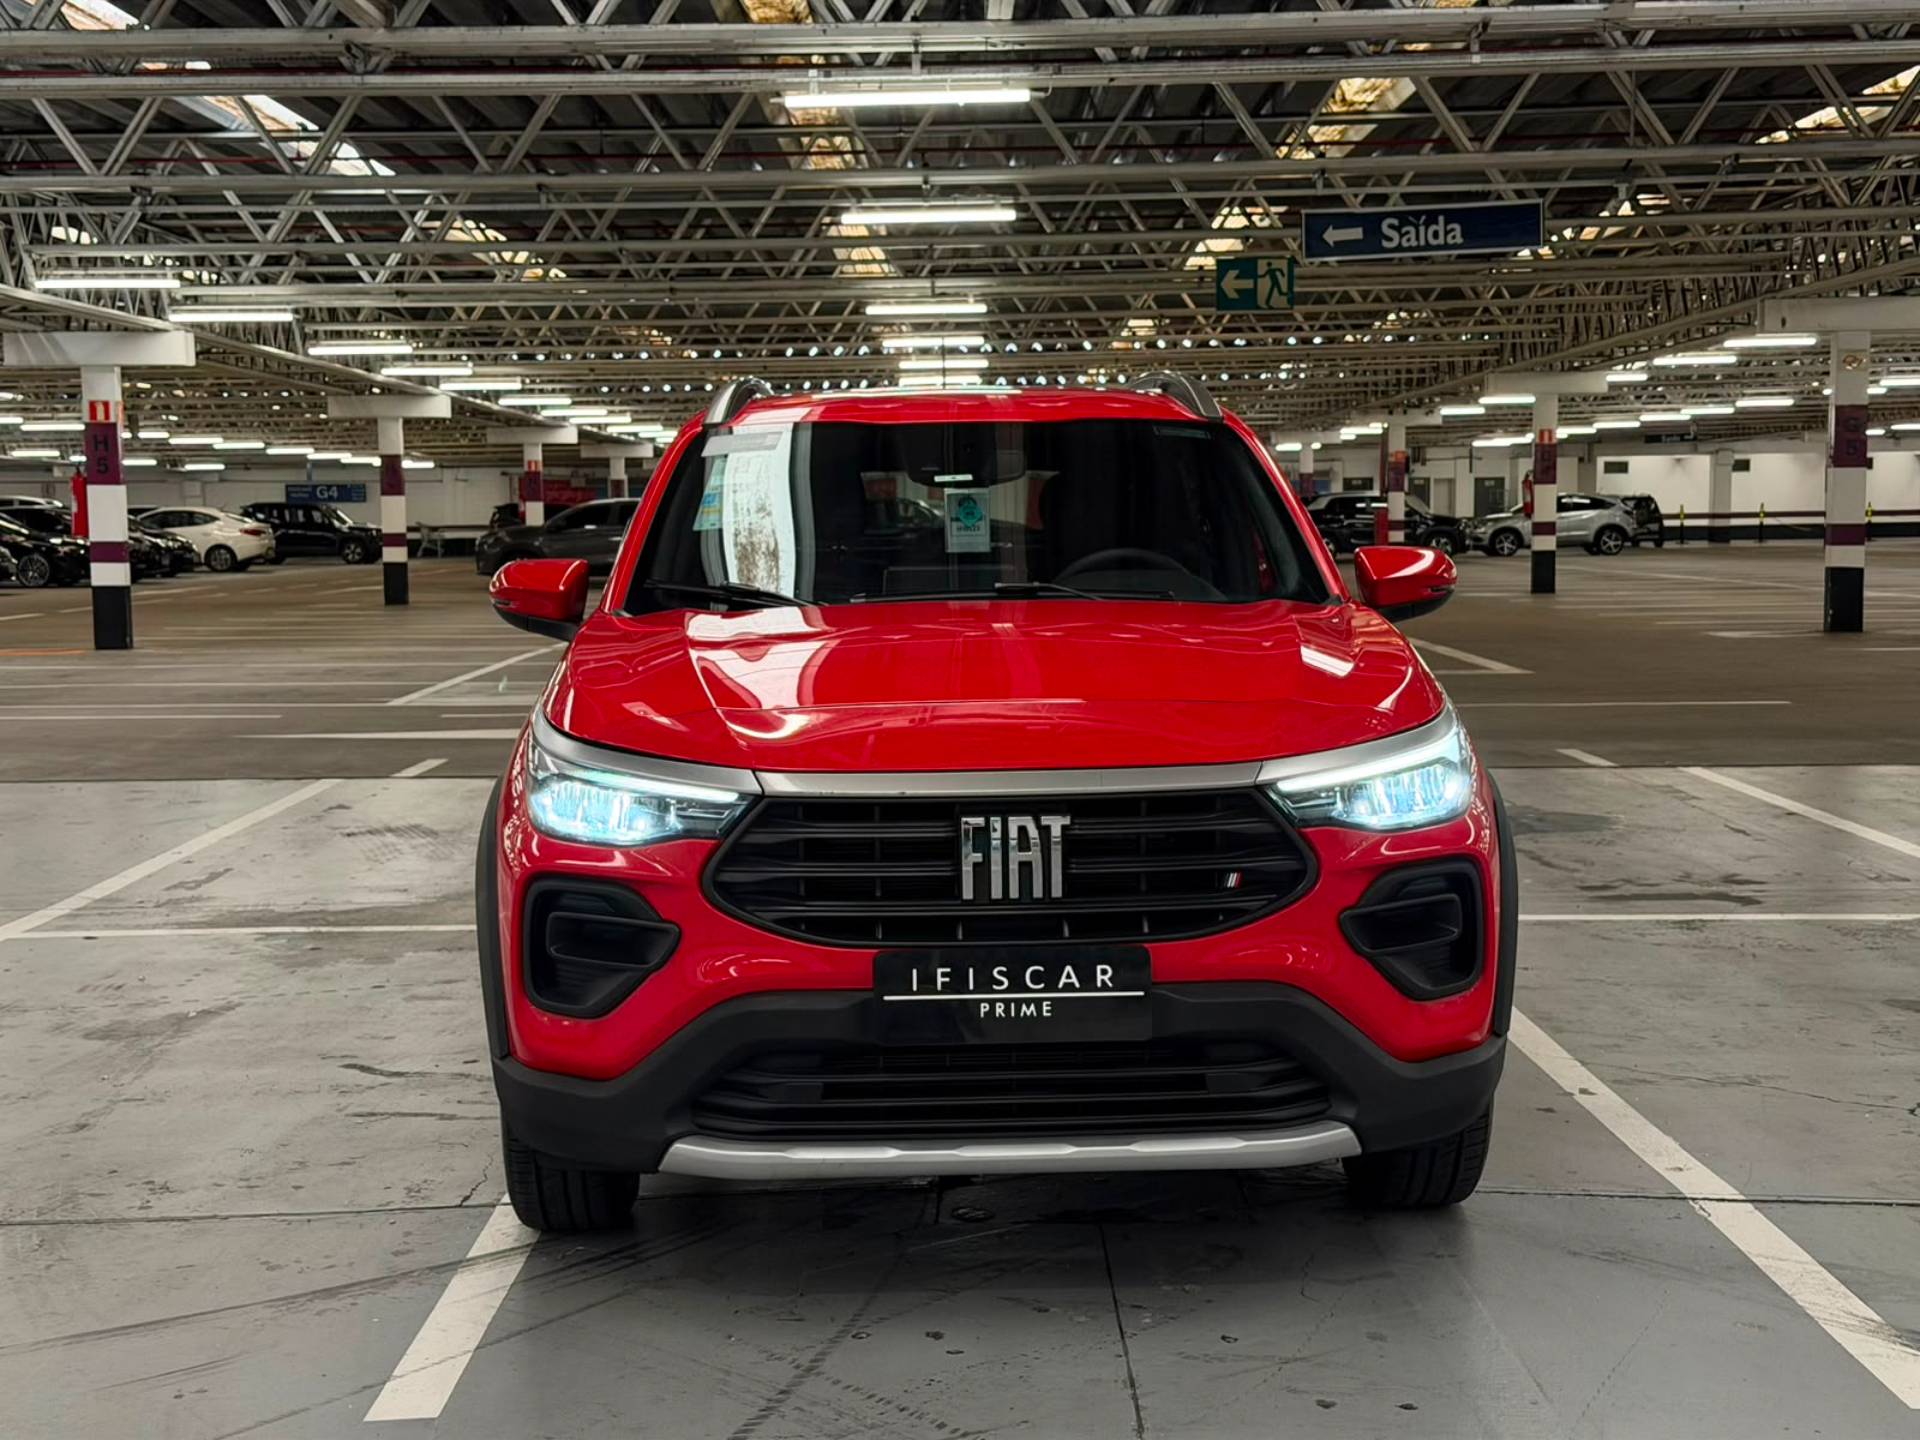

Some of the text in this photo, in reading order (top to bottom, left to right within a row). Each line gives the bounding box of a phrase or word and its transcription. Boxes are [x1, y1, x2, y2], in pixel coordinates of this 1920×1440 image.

[1381, 215, 1463, 249] Saída
[92, 432, 109, 452] H
[96, 457, 109, 475] 5
[316, 486, 338, 499] G4
[960, 815, 1071, 900] FIAT
[912, 964, 1115, 992] IFISCAR
[979, 1000, 1053, 1018] PRIME
